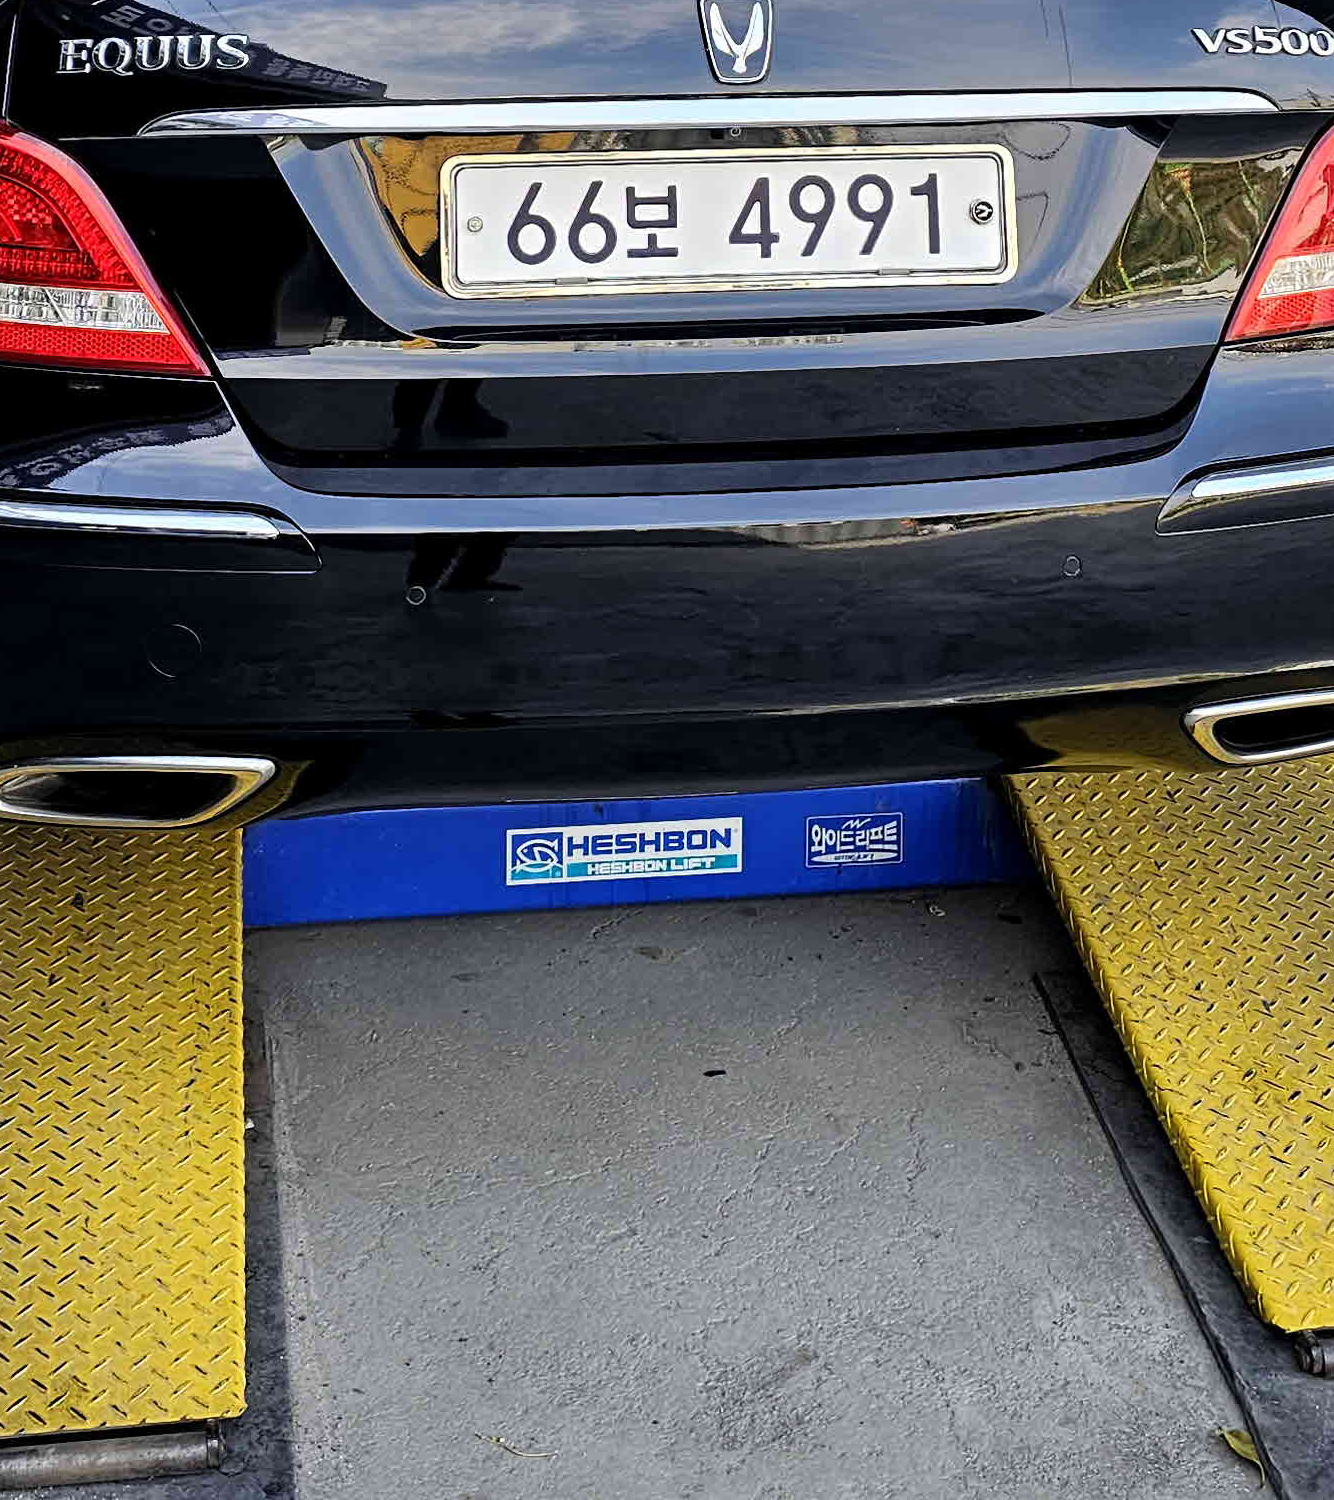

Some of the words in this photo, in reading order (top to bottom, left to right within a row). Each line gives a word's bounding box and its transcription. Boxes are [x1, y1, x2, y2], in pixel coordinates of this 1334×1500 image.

[56, 33, 251, 77] EQUUS
[507, 180, 679, 265] 66보
[728, 173, 941, 259] 4991
[567, 828, 731, 857] HESHBON
[811, 821, 898, 854] 와이드리프트
[587, 859, 668, 876] HESHBON
[670, 857, 716, 870] LIFT
